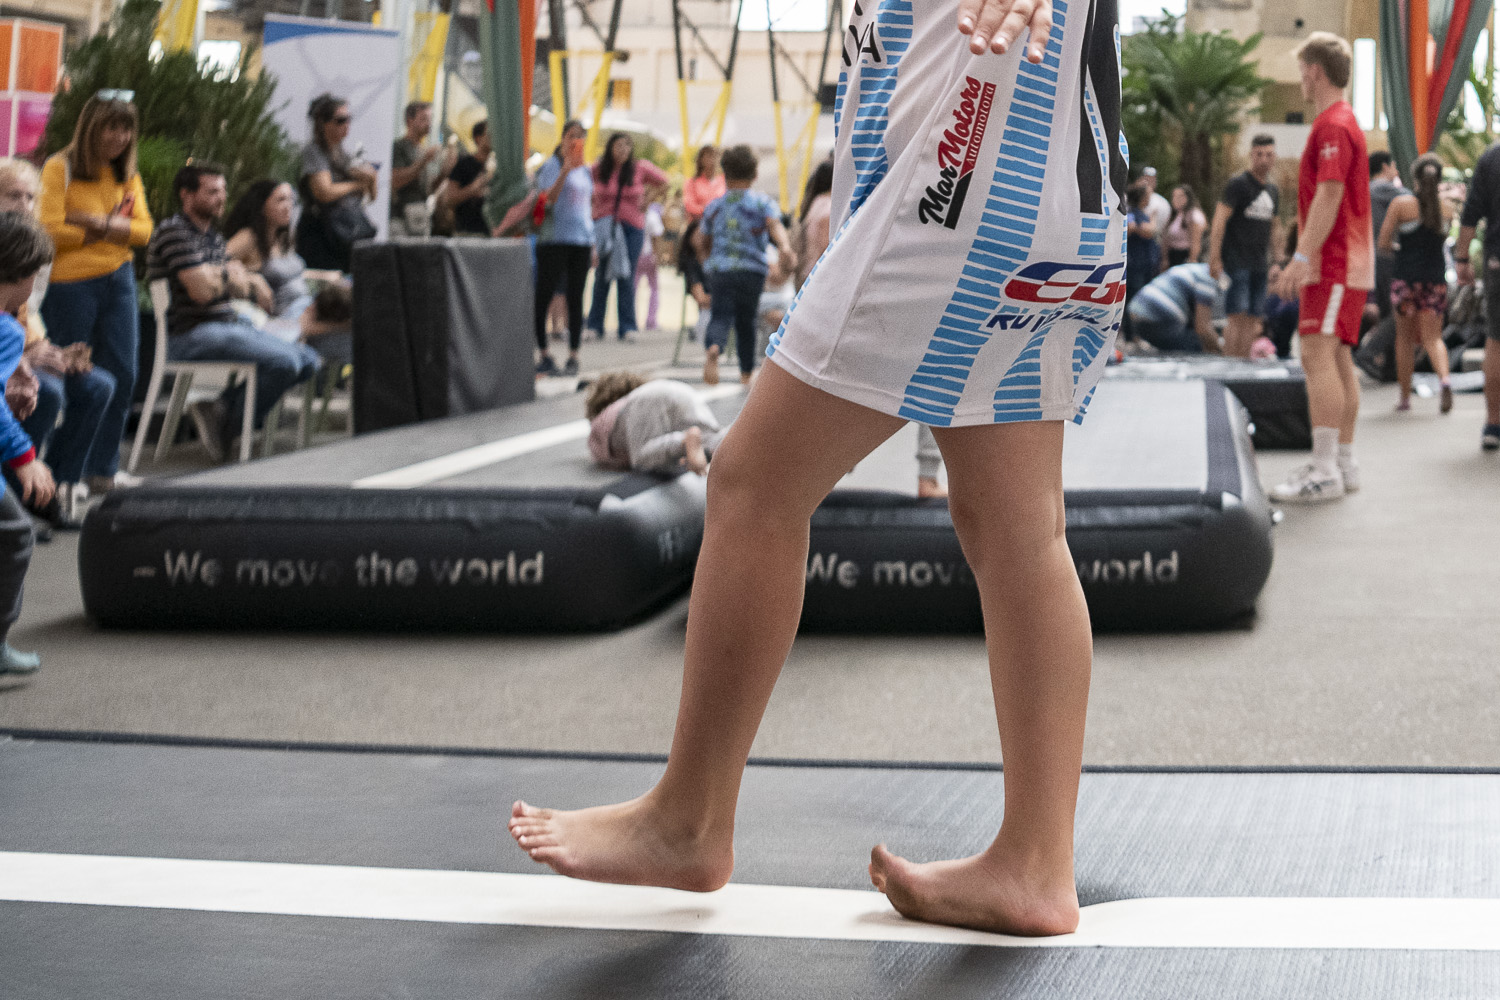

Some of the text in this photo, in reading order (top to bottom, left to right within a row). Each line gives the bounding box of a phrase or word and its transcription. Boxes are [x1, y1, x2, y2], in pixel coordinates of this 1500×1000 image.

[965, 85, 995, 167] Automotora
[164, 549, 221, 587] We
[355, 550, 418, 587] the
[430, 549, 545, 587] world
[805, 552, 859, 588] We
